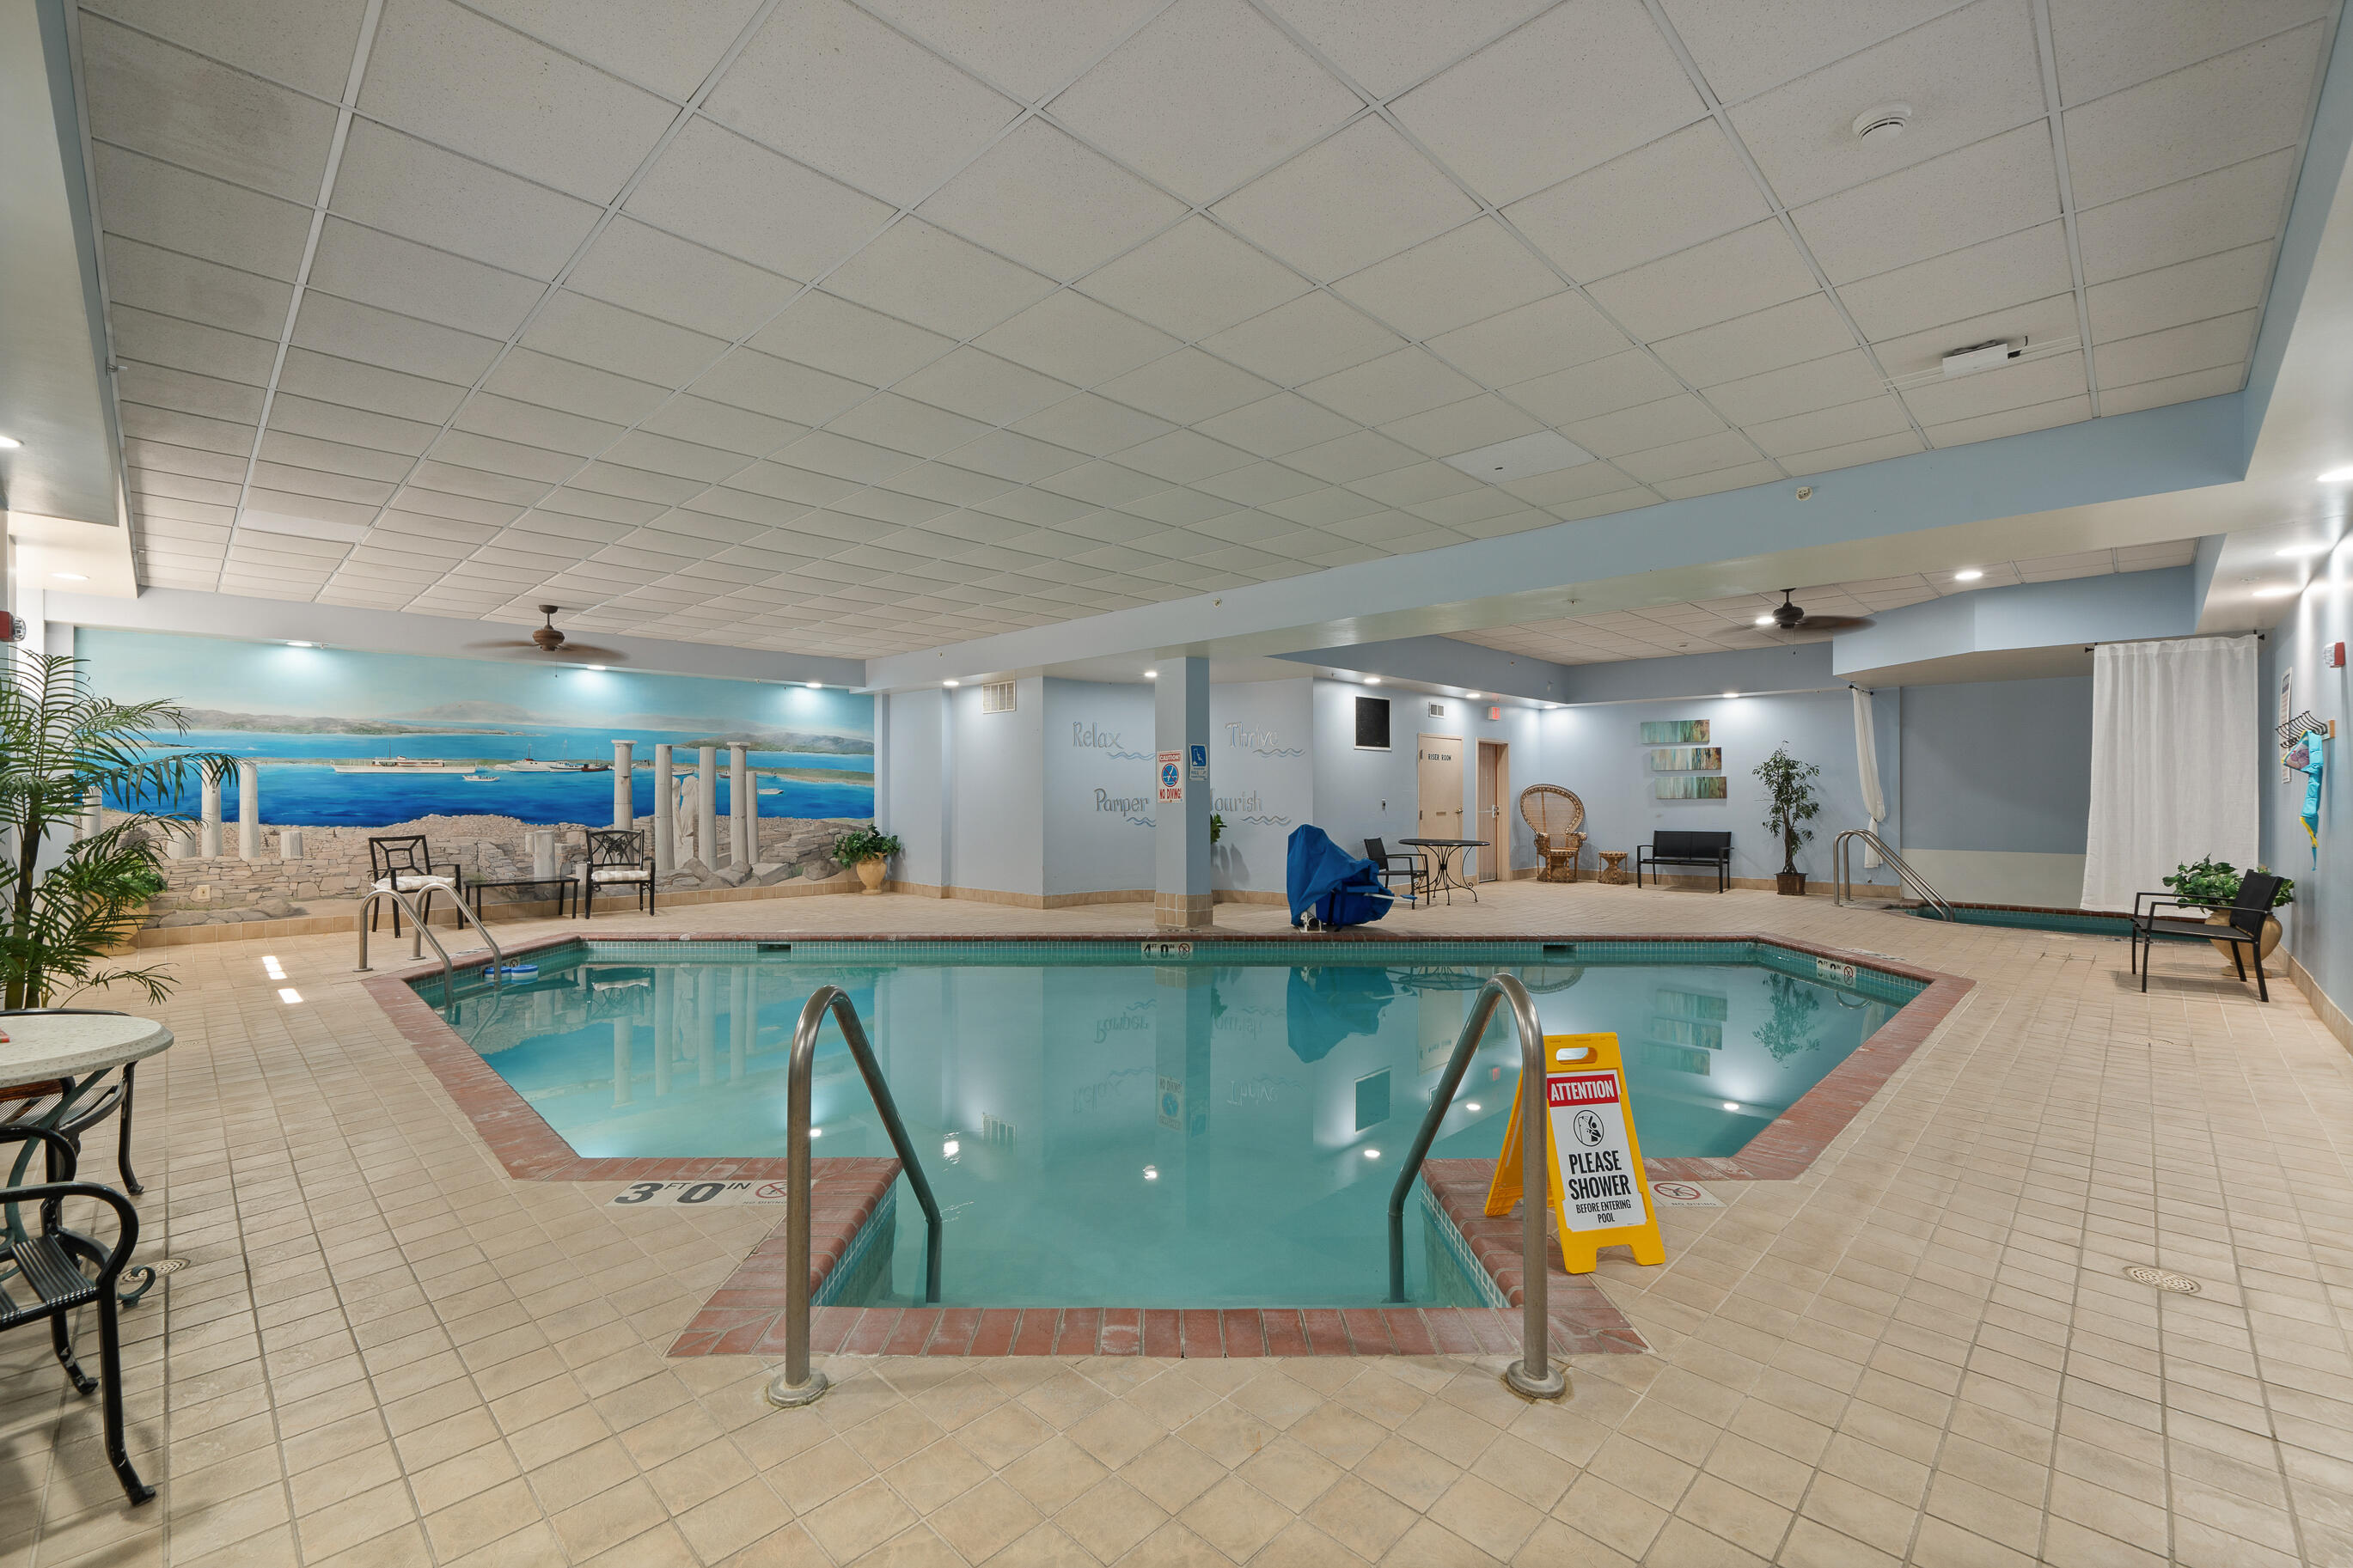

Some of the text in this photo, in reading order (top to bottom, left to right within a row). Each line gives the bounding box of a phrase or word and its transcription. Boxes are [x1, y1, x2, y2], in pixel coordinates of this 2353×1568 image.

[1073, 721, 1124, 749] Relax
[1225, 721, 1278, 749] Thrive
[1094, 788, 1150, 817] Pamper
[1159, 789, 1165, 799] NO
[1550, 1080, 1615, 1101] ATTENTION
[1568, 1150, 1623, 1174] PLEASE
[614, 1182, 663, 1204] 3
[676, 1182, 725, 1204] 0
[1568, 1174, 1631, 1200] SHOWER
[1575, 1199, 1631, 1214] BEFORE ENTERING
[1597, 1212, 1616, 1223] POOL
